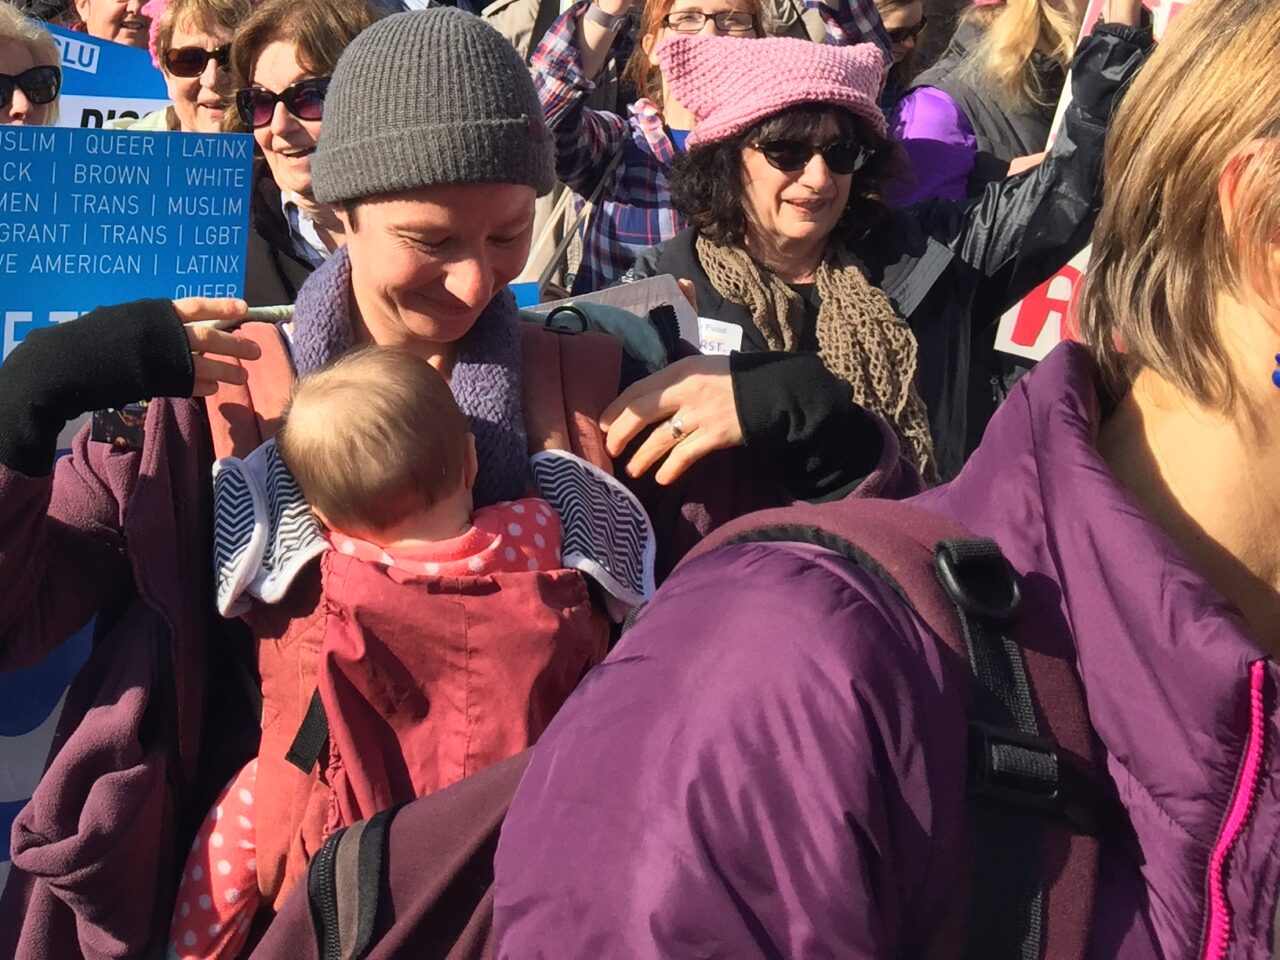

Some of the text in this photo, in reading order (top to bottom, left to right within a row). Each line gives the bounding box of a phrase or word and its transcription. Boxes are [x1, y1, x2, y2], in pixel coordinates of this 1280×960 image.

[86, 134, 154, 156] QUEER
[182, 138, 247, 159] LATINX
[74, 164, 150, 185] BROWN
[186, 168, 245, 187] WHITE
[71, 194, 139, 215] TRANS
[169, 197, 242, 216] MUSLIM
[101, 225, 167, 244] TRANS
[194, 226, 242, 245] LGBT
[29, 254, 140, 274] AMERICAN
[176, 255, 240, 274] LATINX
